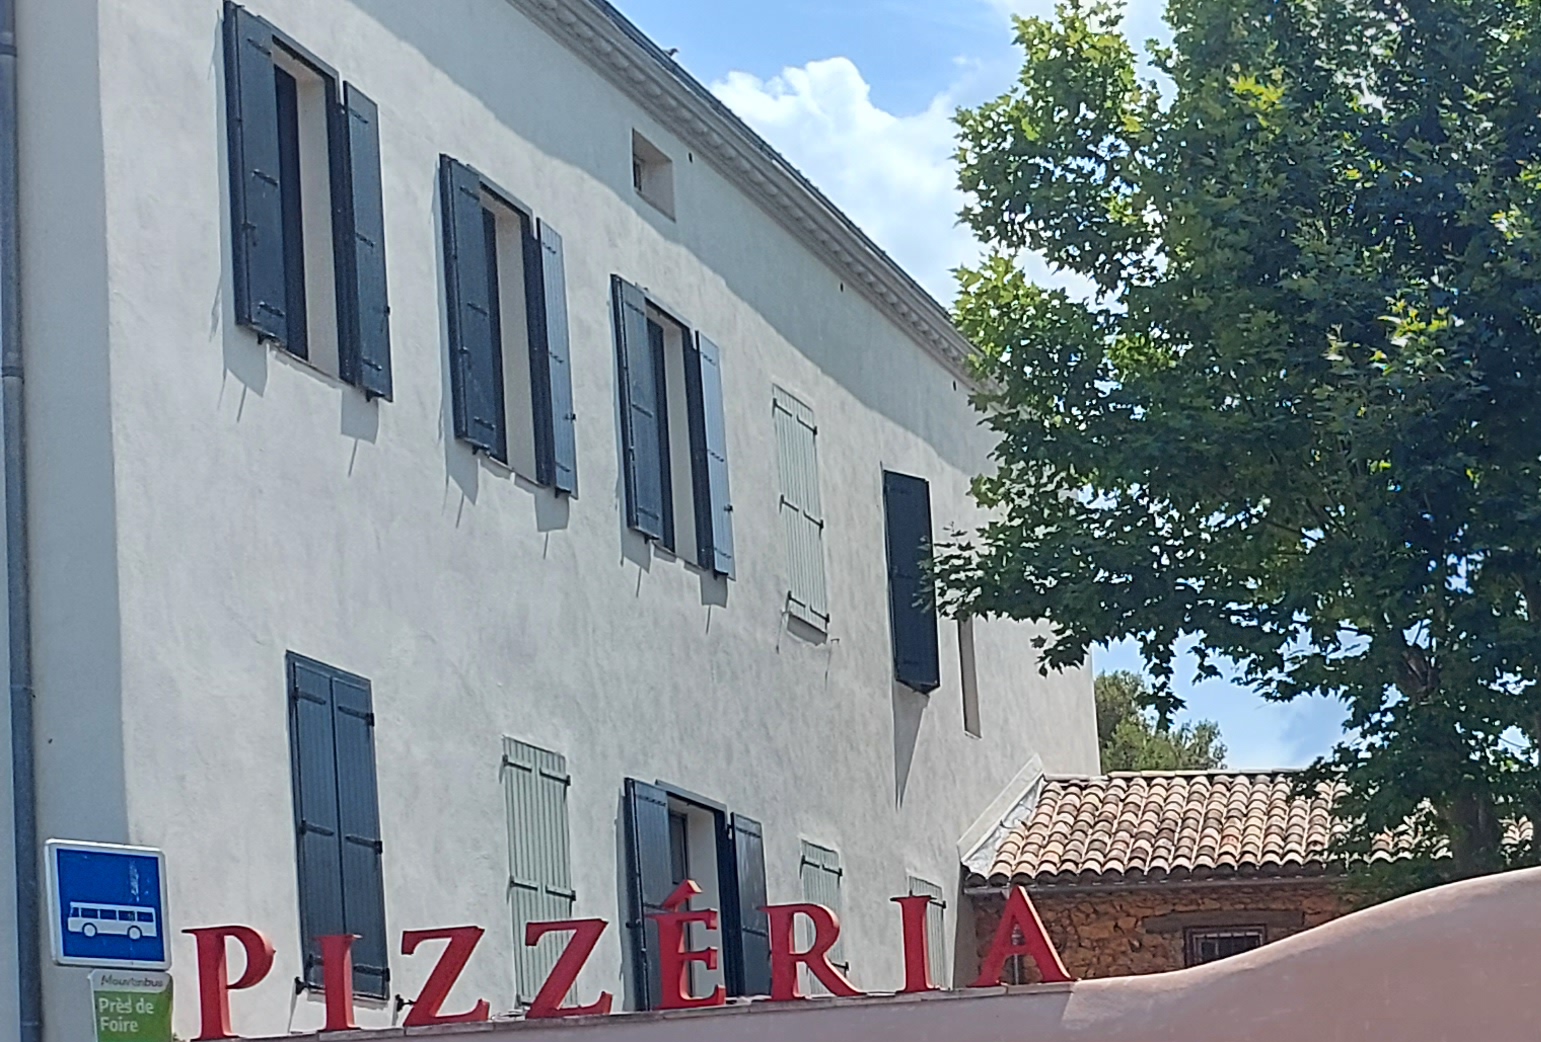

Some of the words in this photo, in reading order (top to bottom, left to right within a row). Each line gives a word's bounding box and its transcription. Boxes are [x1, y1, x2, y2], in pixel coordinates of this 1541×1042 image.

[181, 879, 1074, 1042] PIZZÉRIA
[135, 997, 155, 1014] de
[100, 1016, 140, 1033] Foire
